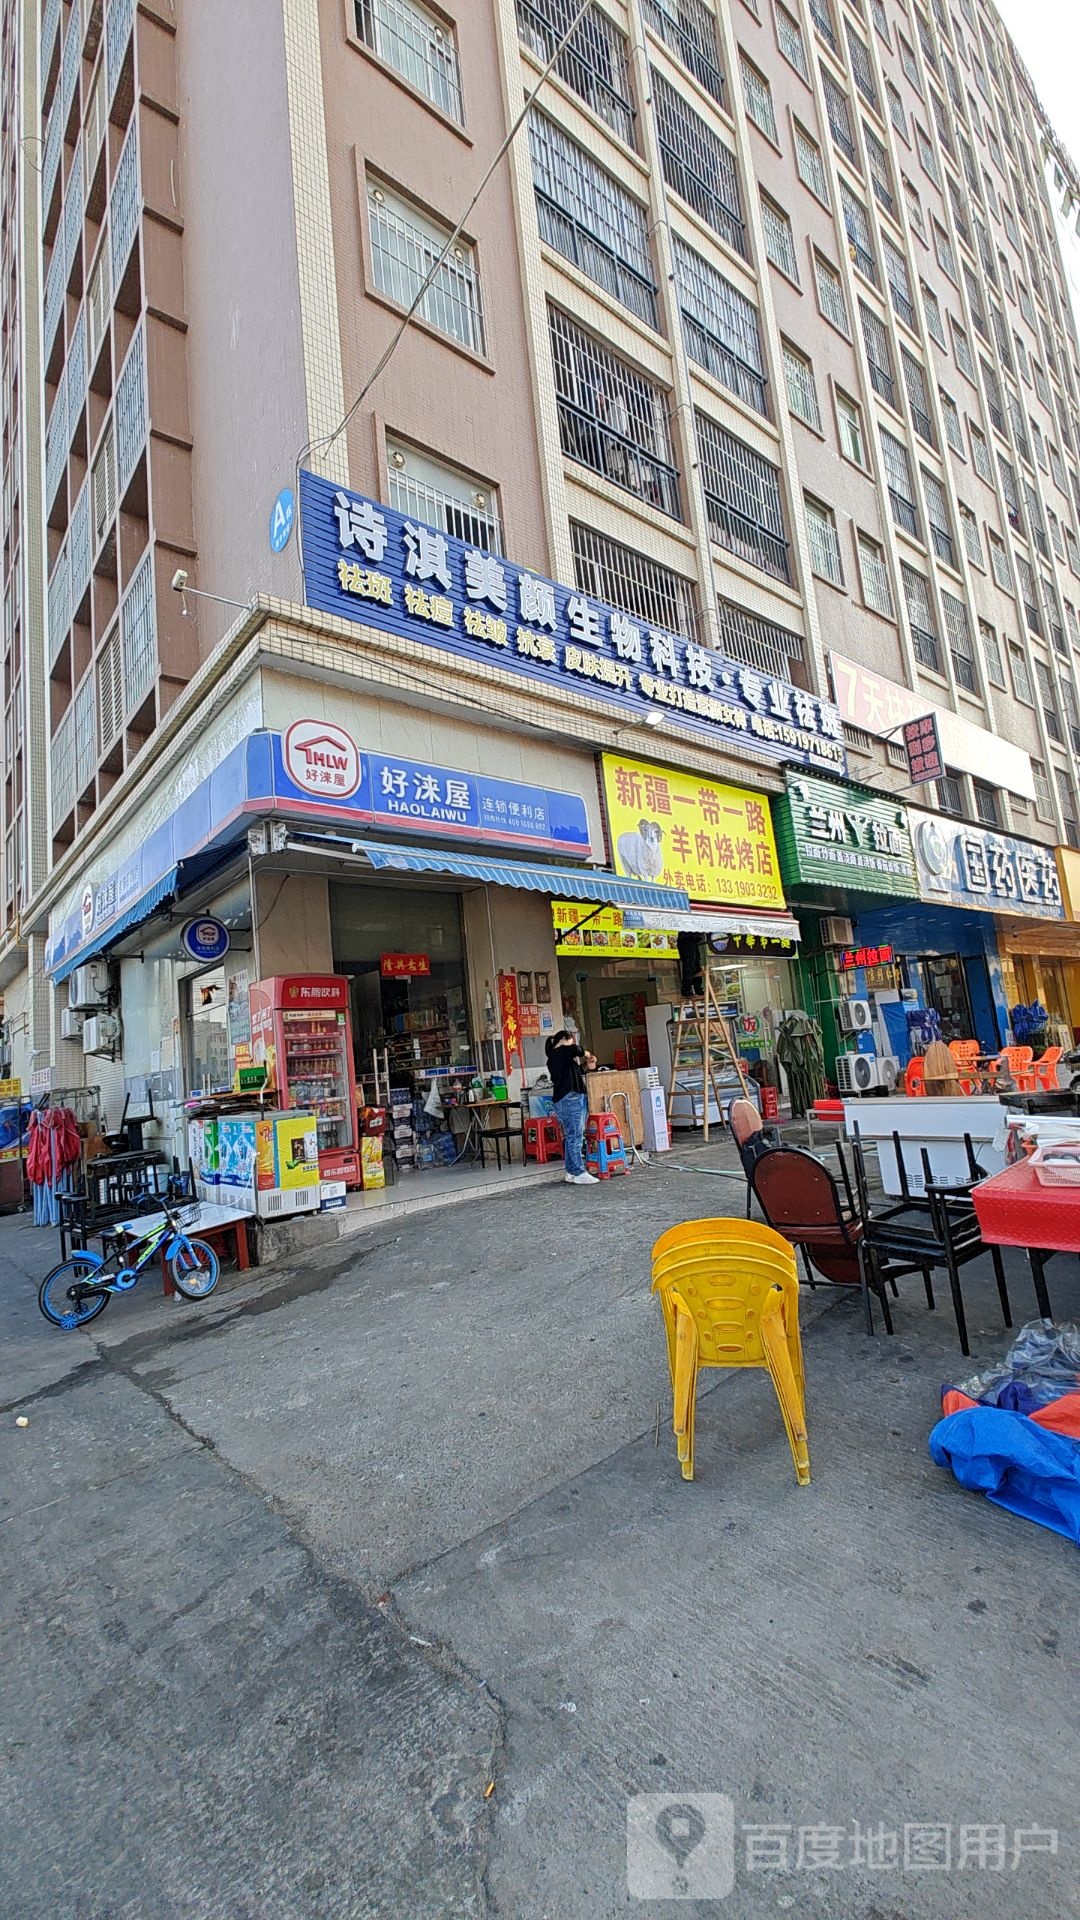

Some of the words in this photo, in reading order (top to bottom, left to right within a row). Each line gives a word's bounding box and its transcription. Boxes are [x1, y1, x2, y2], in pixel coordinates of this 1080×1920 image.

[338, 559, 394, 605] 祛斑
[404, 584, 455, 627] 祛痘
[463, 606, 508, 646] 祛皱
[517, 626, 557, 663] 抗衰
[565, 645, 633, 690] 皮肤提升
[305, 768, 347, 787] 好涞屋
[380, 767, 472, 811] 好涞屋
[388, 800, 467, 822] HAOLAIWU
[482, 797, 546, 821] 连锁便利店
[614, 768, 766, 837] 新疆一带一路
[670, 824, 774, 877] 羊肉烧烤店
[959, 833, 1062, 907] 国药医药
[716, 878, 733, 894] 133
[757, 884, 778, 900] 3232
[556, 906, 622, 927] 新疆一带一路
[844, 946, 892, 970] 兰州拉面
[301, 987, 340, 998] 东鹏饮料
